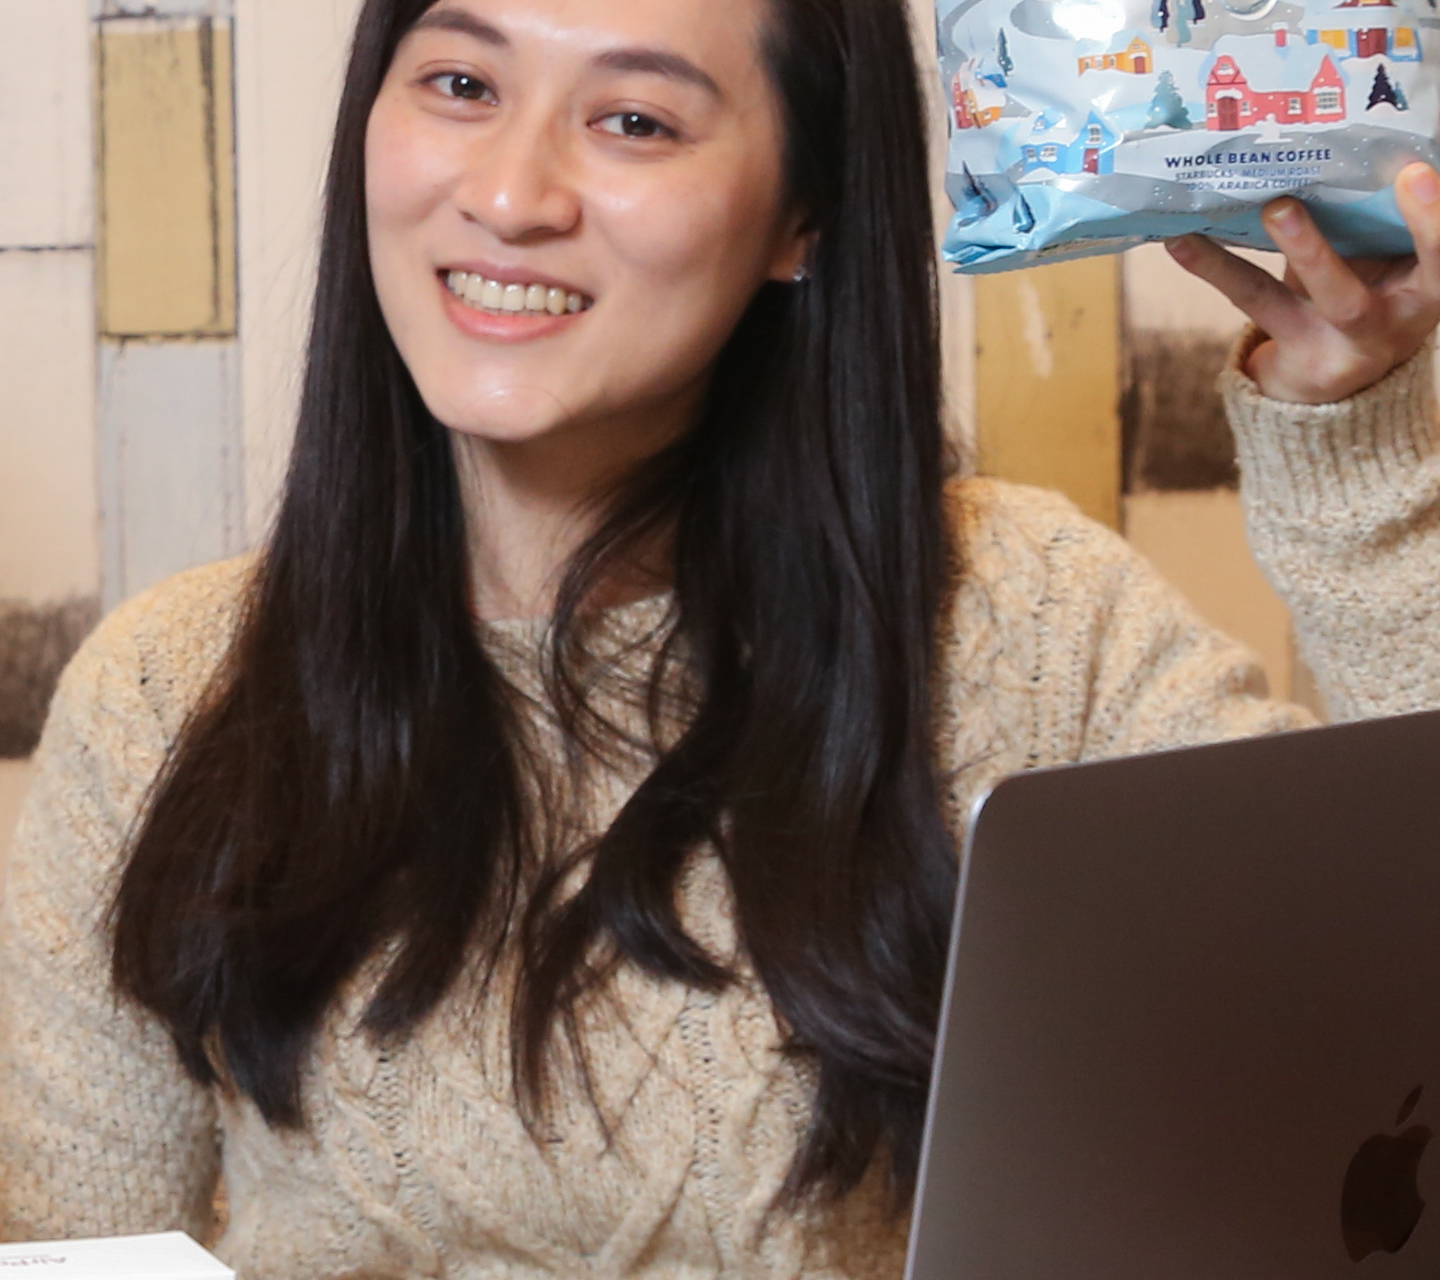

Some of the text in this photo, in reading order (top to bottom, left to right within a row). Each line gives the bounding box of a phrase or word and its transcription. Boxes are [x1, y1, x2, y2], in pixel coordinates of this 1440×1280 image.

[1165, 148, 1332, 168] WHOLE BEAN COFFEE
[1241, 168, 1286, 178] MEDIUM
[1288, 166, 1323, 178] ROAST
[1219, 180, 1269, 191] ARABICA
